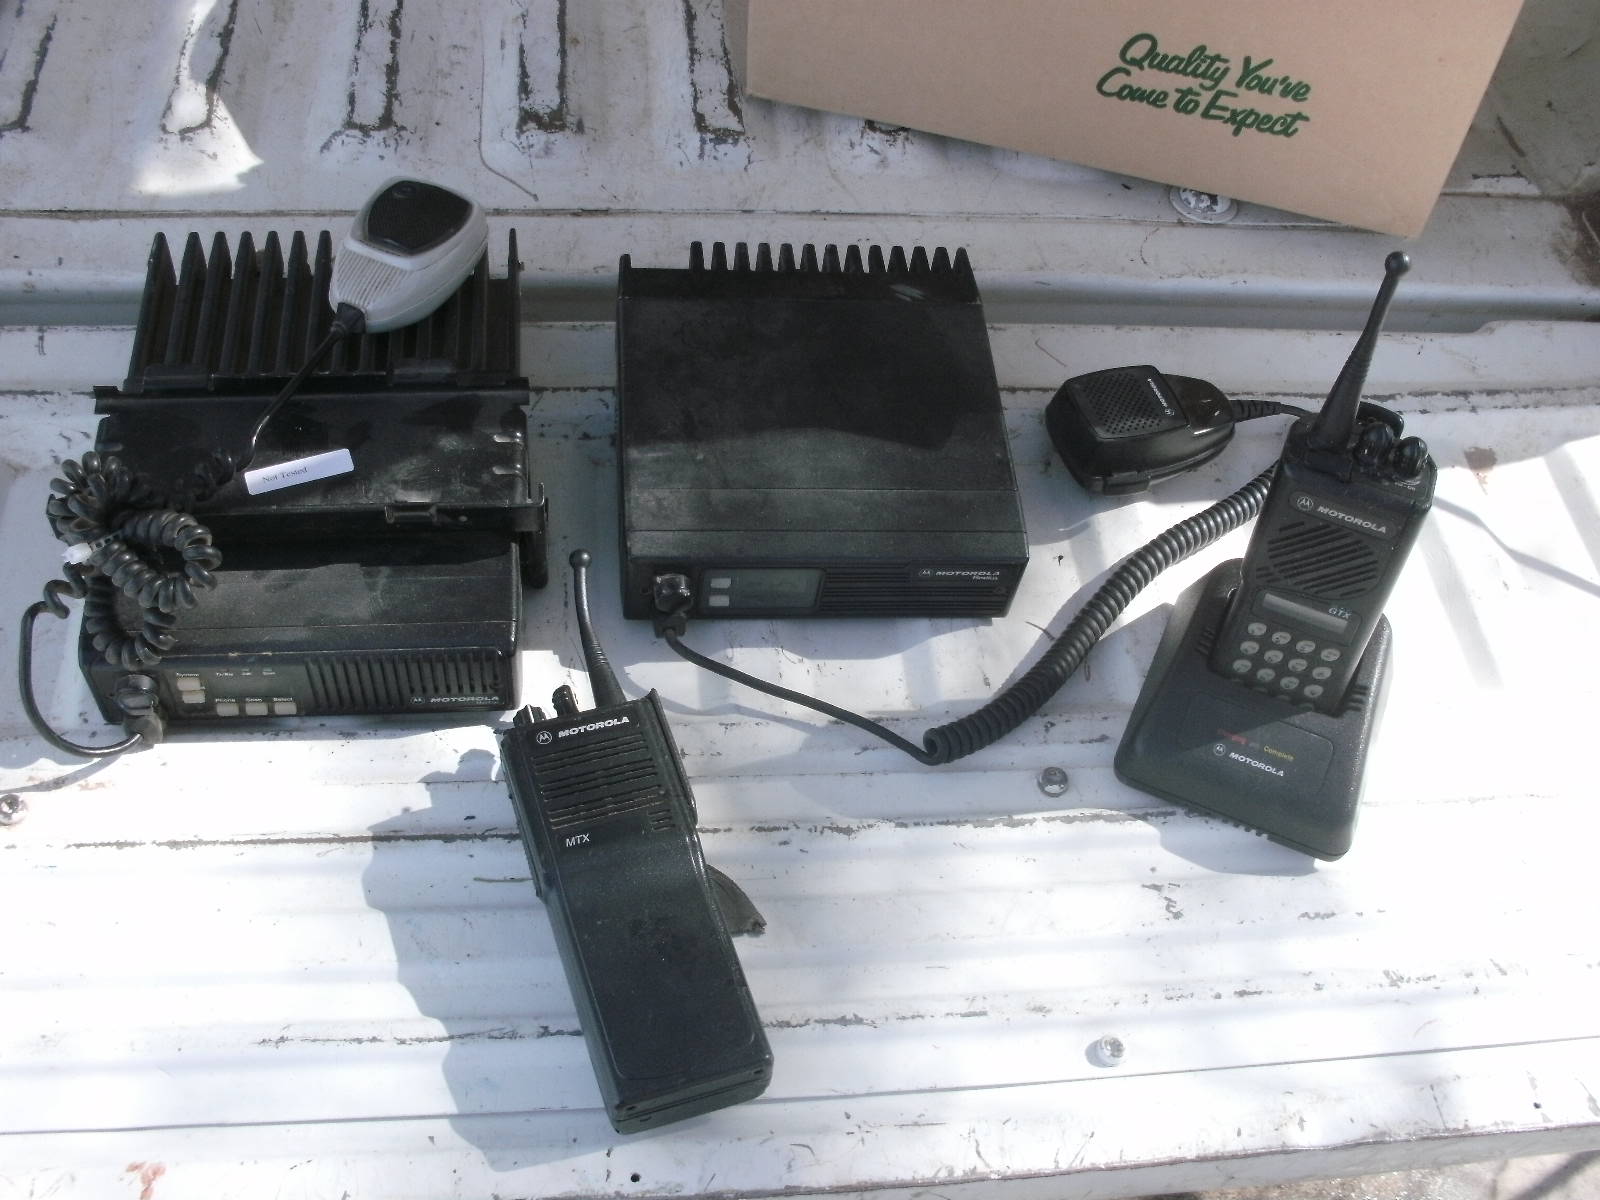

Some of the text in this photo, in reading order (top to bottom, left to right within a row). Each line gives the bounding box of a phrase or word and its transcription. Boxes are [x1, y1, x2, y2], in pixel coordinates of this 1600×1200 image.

[1119, 33, 1311, 102] Quality You've
[1096, 66, 1310, 138] Come to Expect
[262, 466, 308, 483] Not Tested
[1317, 506, 1386, 534] MOTOROLA
[558, 716, 630, 739] MOTOROLA
[1228, 752, 1284, 777] MOTOROLA
[565, 833, 590, 848] MTX
